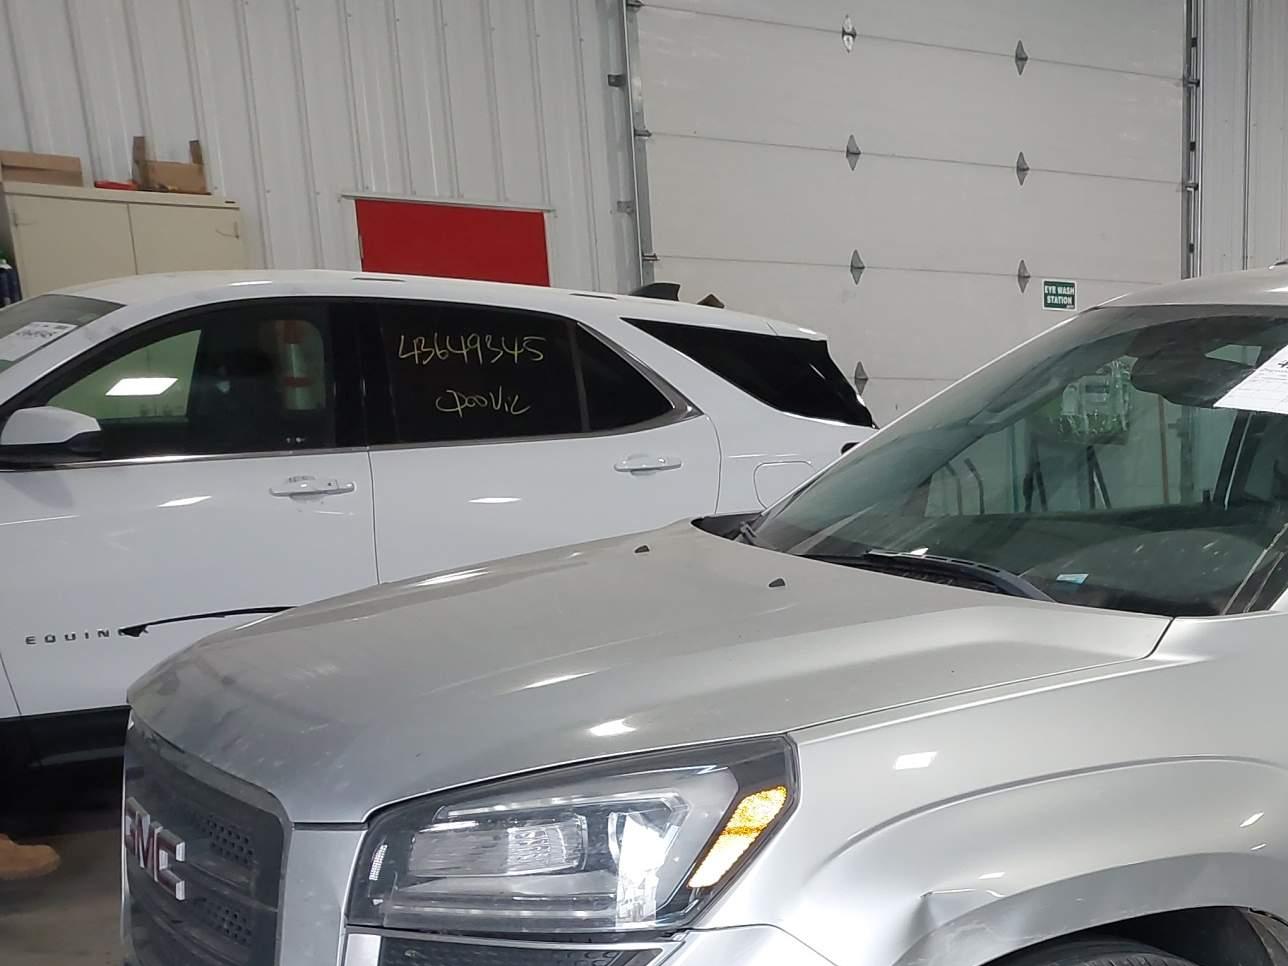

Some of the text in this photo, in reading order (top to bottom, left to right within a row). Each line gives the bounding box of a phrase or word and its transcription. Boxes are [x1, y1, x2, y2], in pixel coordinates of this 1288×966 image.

[1044, 285, 1075, 295] EYE WASH
[1046, 295, 1073, 305] STATION
[398, 332, 547, 365] 43649345
